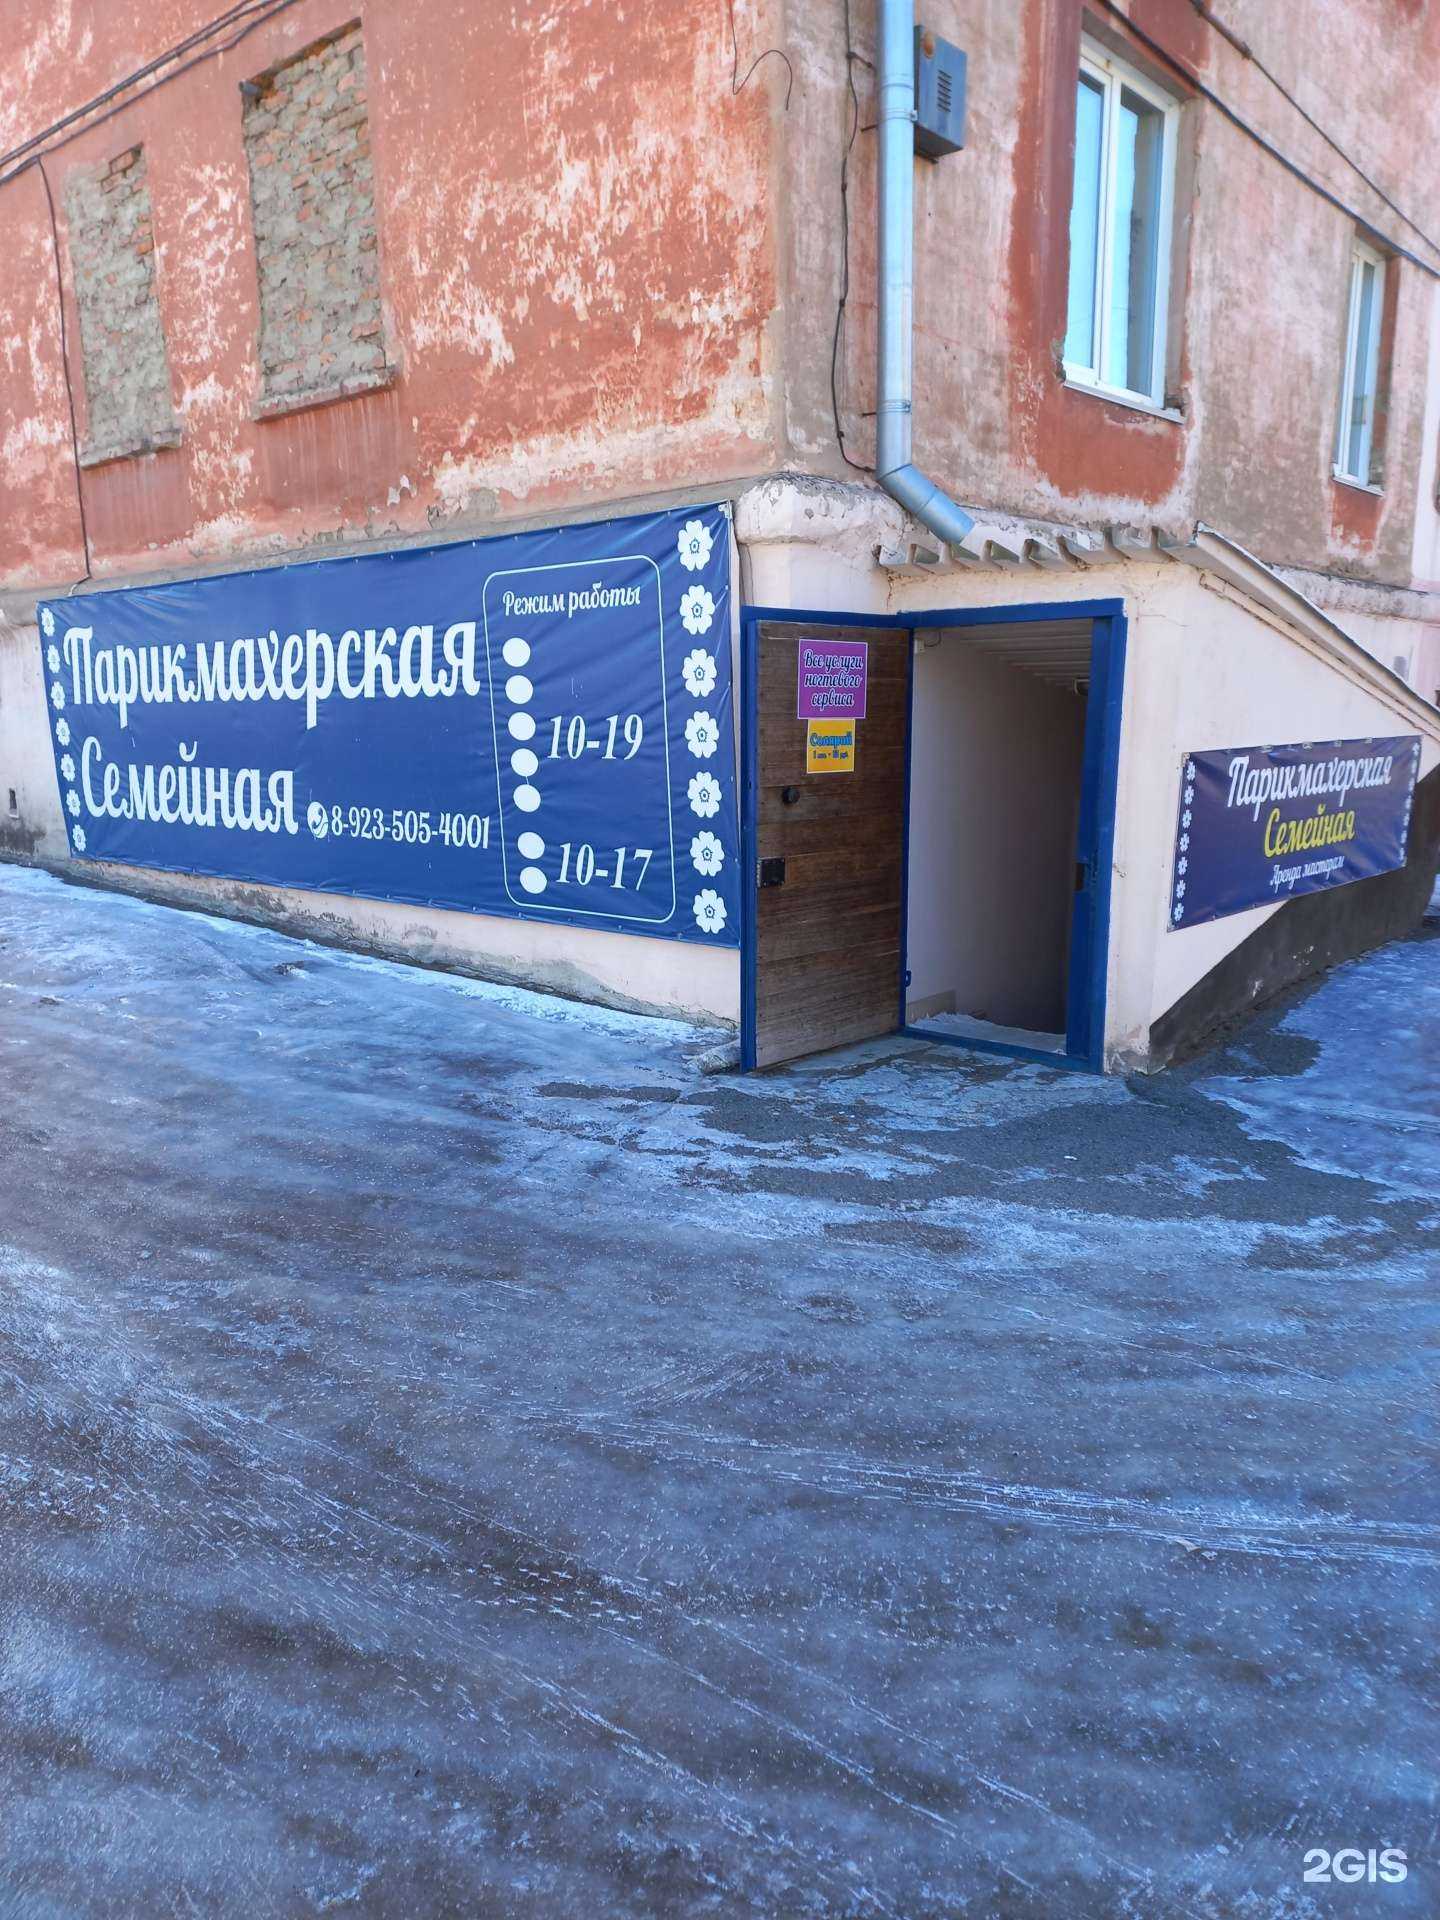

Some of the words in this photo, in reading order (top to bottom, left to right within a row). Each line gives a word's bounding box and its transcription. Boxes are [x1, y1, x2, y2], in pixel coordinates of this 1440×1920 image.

[503, 590, 565, 616] Режим
[568, 581, 641, 618] работы
[63, 621, 480, 729] Парикмахерская
[804, 649, 824, 668] Все
[825, 654, 863, 672] услуги
[804, 671, 861, 688] ногтевого
[811, 688, 854, 711] сервиса
[546, 713, 644, 761] 10-19
[81, 736, 298, 835] Семейная
[1226, 755, 1393, 822] Парикмахерская
[331, 806, 490, 849] 8-923-505-4001
[1263, 804, 1356, 858] Семейная
[556, 841, 653, 892] 10-17
